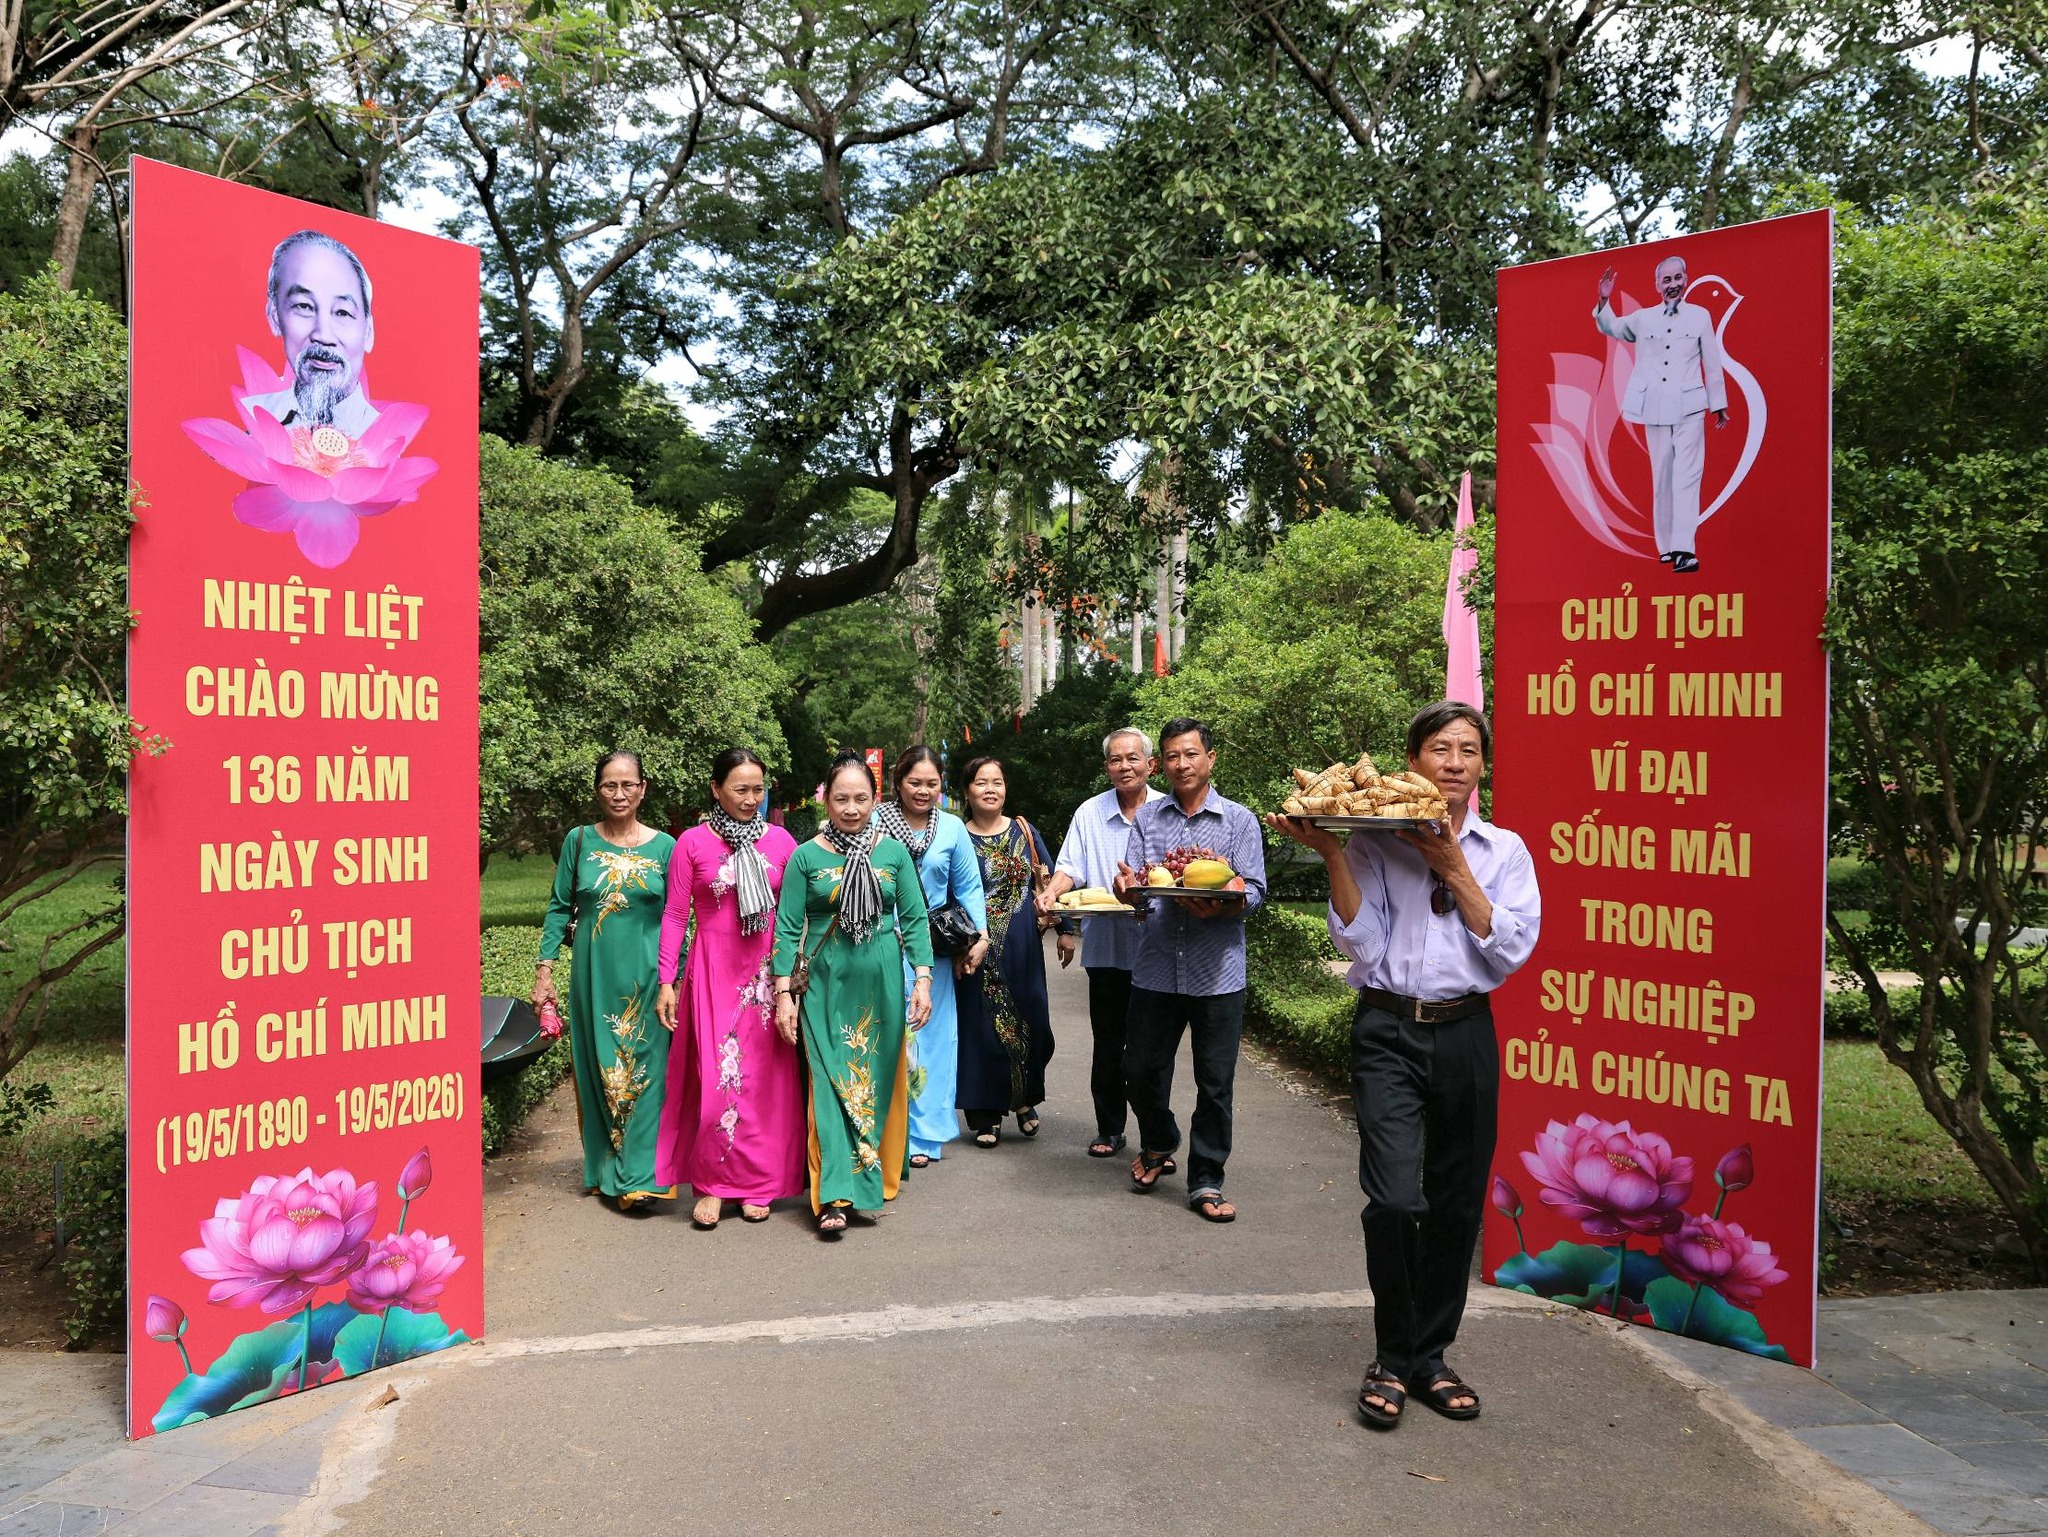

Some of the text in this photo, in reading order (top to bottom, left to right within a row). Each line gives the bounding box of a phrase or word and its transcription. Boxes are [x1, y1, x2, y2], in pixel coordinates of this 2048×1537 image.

[204, 575, 424, 650] NHIỆT LIỆT
[1561, 582, 1744, 649] CHỦ TỊCH
[185, 657, 439, 722] CHÀO MỪNG
[1527, 658, 1783, 718] HỒ CHÍ MINH
[222, 745, 409, 804] 136 NĂM
[1591, 740, 1708, 805] VĨ ĐẠI
[200, 831, 428, 893] NGÀY SINH
[1549, 808, 1750, 878] SỐNG MÃI
[220, 908, 412, 980] CHỦ TỊCH
[1580, 898, 1713, 954] TRONG
[178, 994, 447, 1075] HỒ CHÍ MINH
[1540, 969, 1755, 1044] SỰ NGHIỆP
[1505, 1027, 1793, 1127] CỦA CHÚNG TA
[156, 1094, 308, 1174] (19/5/1890
[335, 1072, 465, 1136] 19/5/2026)
